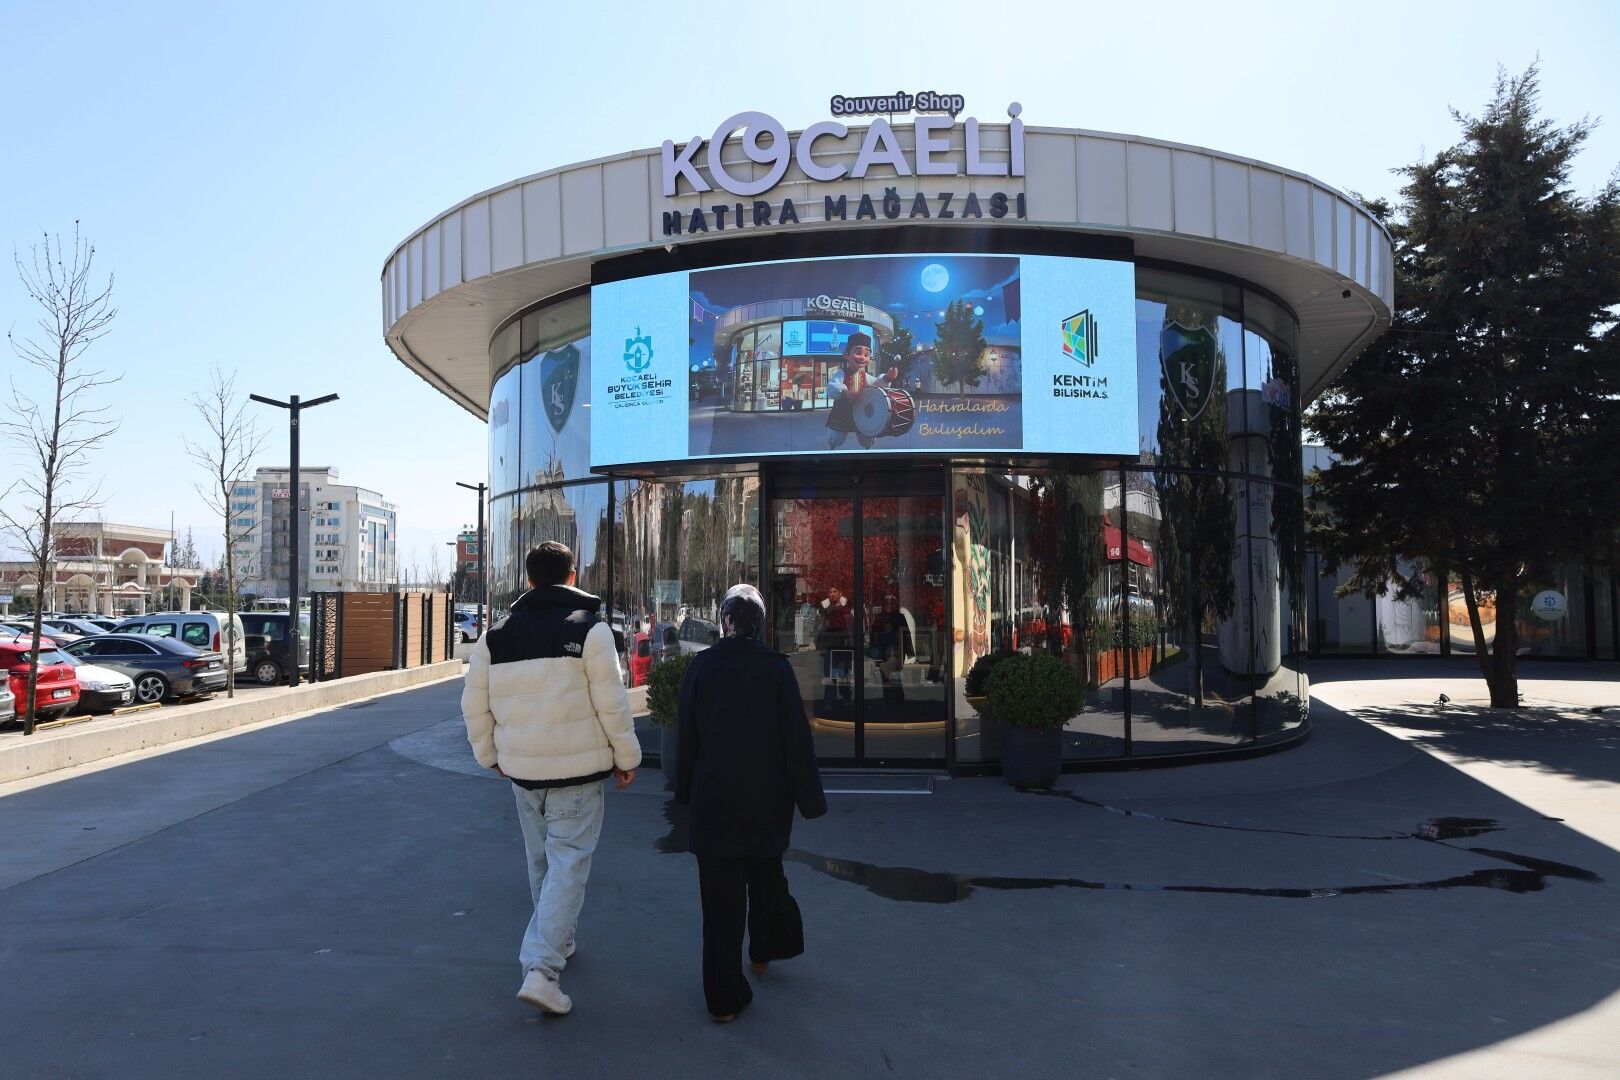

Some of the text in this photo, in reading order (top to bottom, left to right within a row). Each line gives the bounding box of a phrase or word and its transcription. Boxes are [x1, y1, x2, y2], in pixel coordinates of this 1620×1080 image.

[831, 91, 963, 113] Souvenir Shop
[662, 186, 1026, 236] HATIRA MAĞAZASI
[1053, 374, 1107, 388] KENTİM
[919, 422, 1005, 439] Buluşalım
